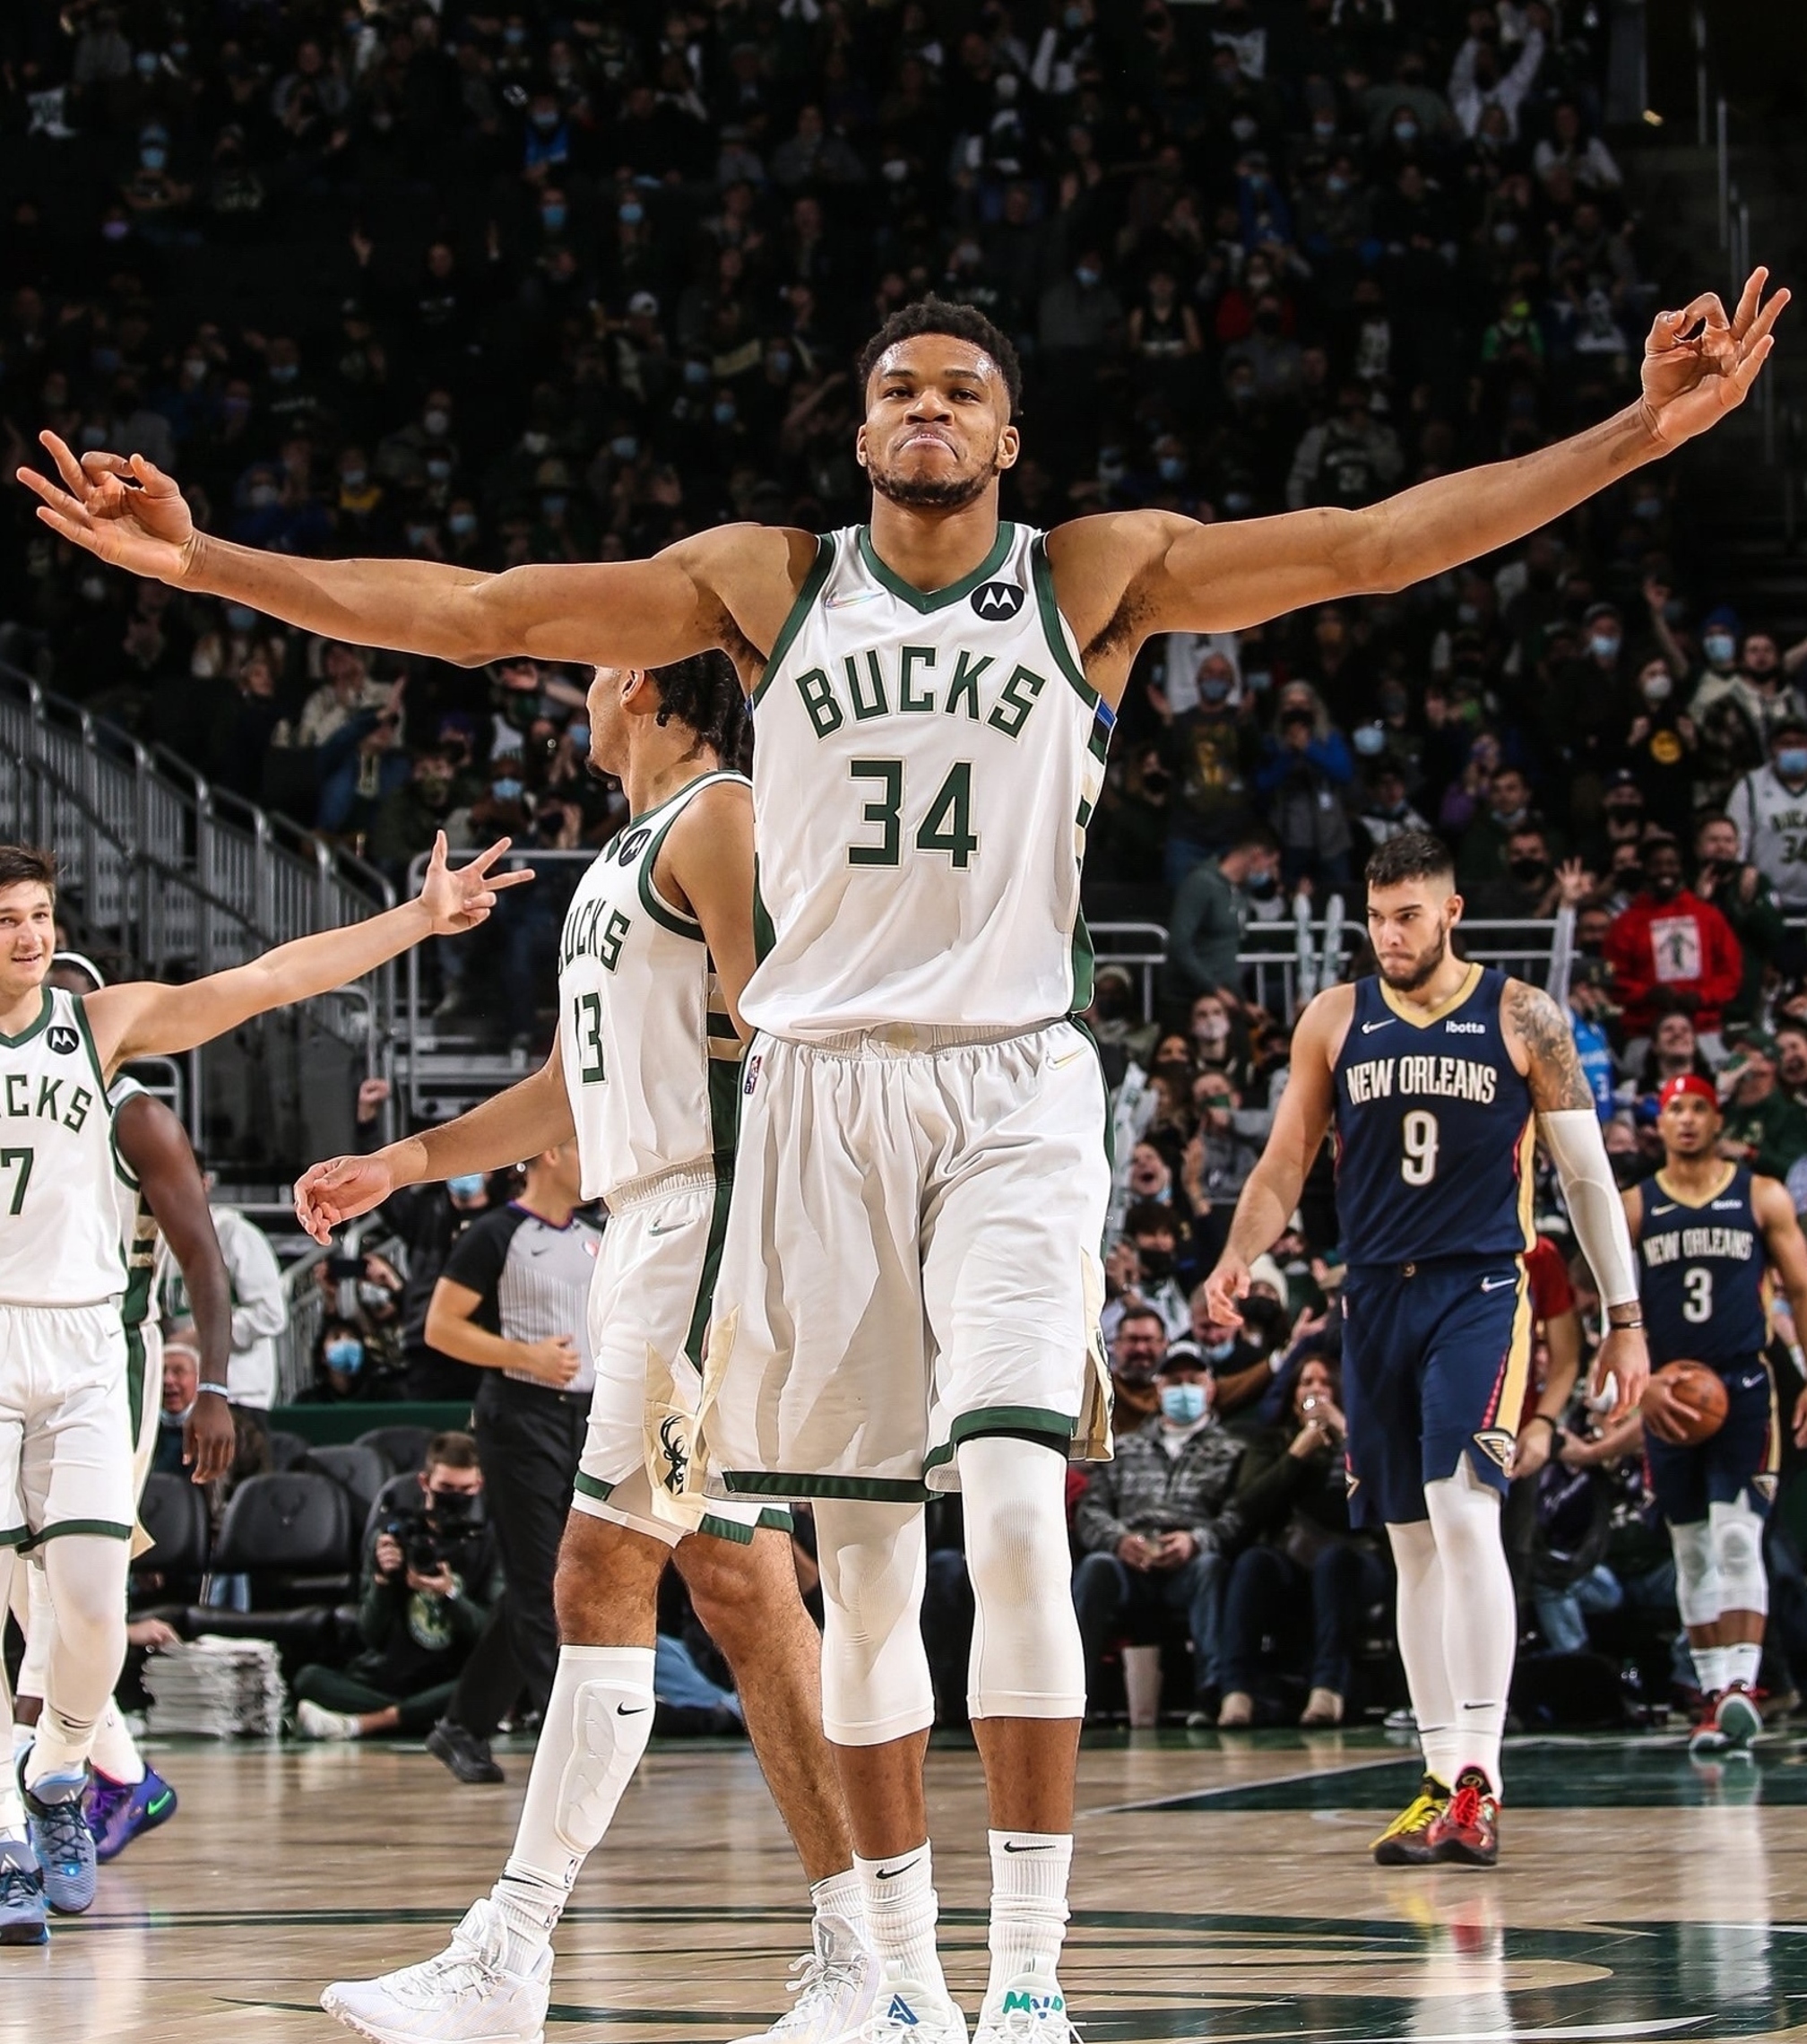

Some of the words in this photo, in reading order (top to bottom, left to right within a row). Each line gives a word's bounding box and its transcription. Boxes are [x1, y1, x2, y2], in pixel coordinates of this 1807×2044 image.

[794, 645, 1049, 743] BUCKS
[845, 755, 981, 871] 34
[558, 897, 635, 974] UCKS
[574, 991, 608, 1086] 13
[1445, 1020, 1486, 1035] ibotta
[0, 1073, 93, 1134] CKS
[1345, 1058, 1396, 1105] NEW
[1398, 1055, 1498, 1104] ORLEANS
[0, 1147, 34, 1216] 7
[1401, 1109, 1440, 1186] 9
[1642, 1231, 1681, 1268] NEW
[1682, 1226, 1754, 1261] ORLEANS
[1682, 1268, 1713, 1323] 3
